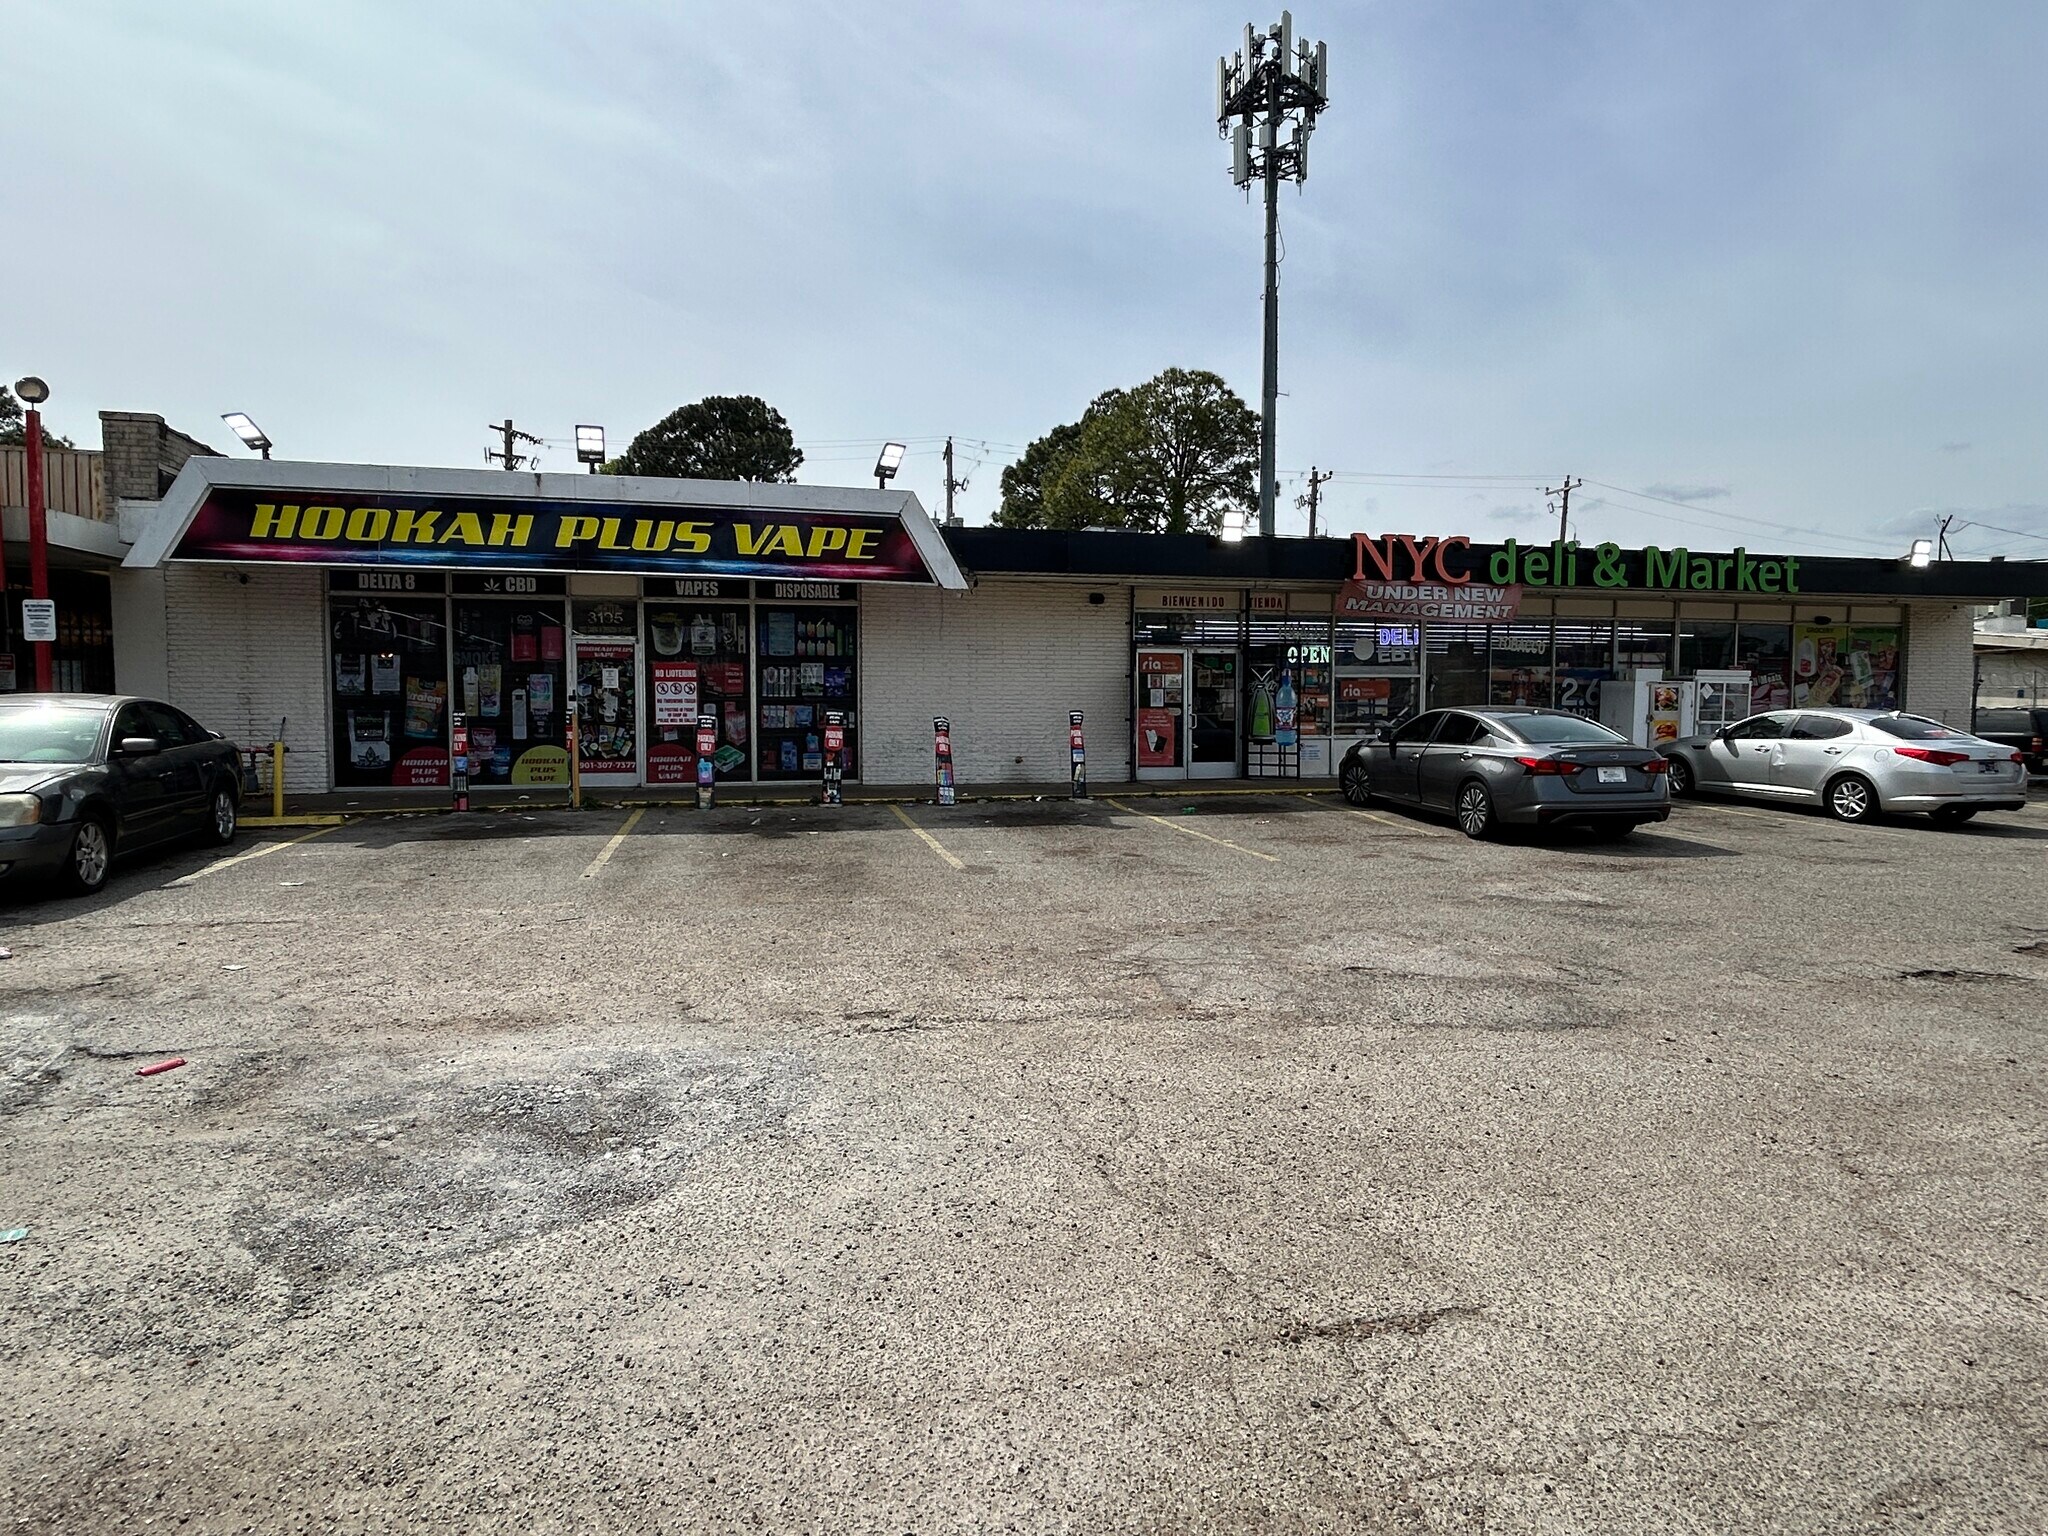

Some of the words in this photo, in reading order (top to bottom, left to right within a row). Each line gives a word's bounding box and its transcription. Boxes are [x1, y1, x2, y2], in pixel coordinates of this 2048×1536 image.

[250, 504, 534, 546] HOOKAH
[555, 516, 714, 553] PLUS
[733, 523, 883, 559] VAPE
[1352, 533, 1471, 584] NYC
[1490, 539, 1576, 586] deli
[1594, 543, 1628, 587] &
[1646, 547, 1800, 593] Market
[358, 573, 402, 589] DELTA
[405, 574, 415, 590] 8
[505, 576, 536, 592] CBD
[675, 580, 719, 596] VAPES
[775, 583, 840, 598] DISPOSABLE
[1366, 585, 1448, 601] UNDER
[1455, 587, 1505, 603] NEW
[1162, 595, 1225, 608] BIENVENIDO
[1250, 597, 1283, 609] TIENDA
[1346, 599, 1512, 619] MANAGEMENT
[587, 611, 624, 624] 3105
[1379, 628, 1419, 646] DELI
[1287, 644, 1331, 664] OPEN
[1142, 656, 1161, 670] ria
[1343, 684, 1361, 697] ria
